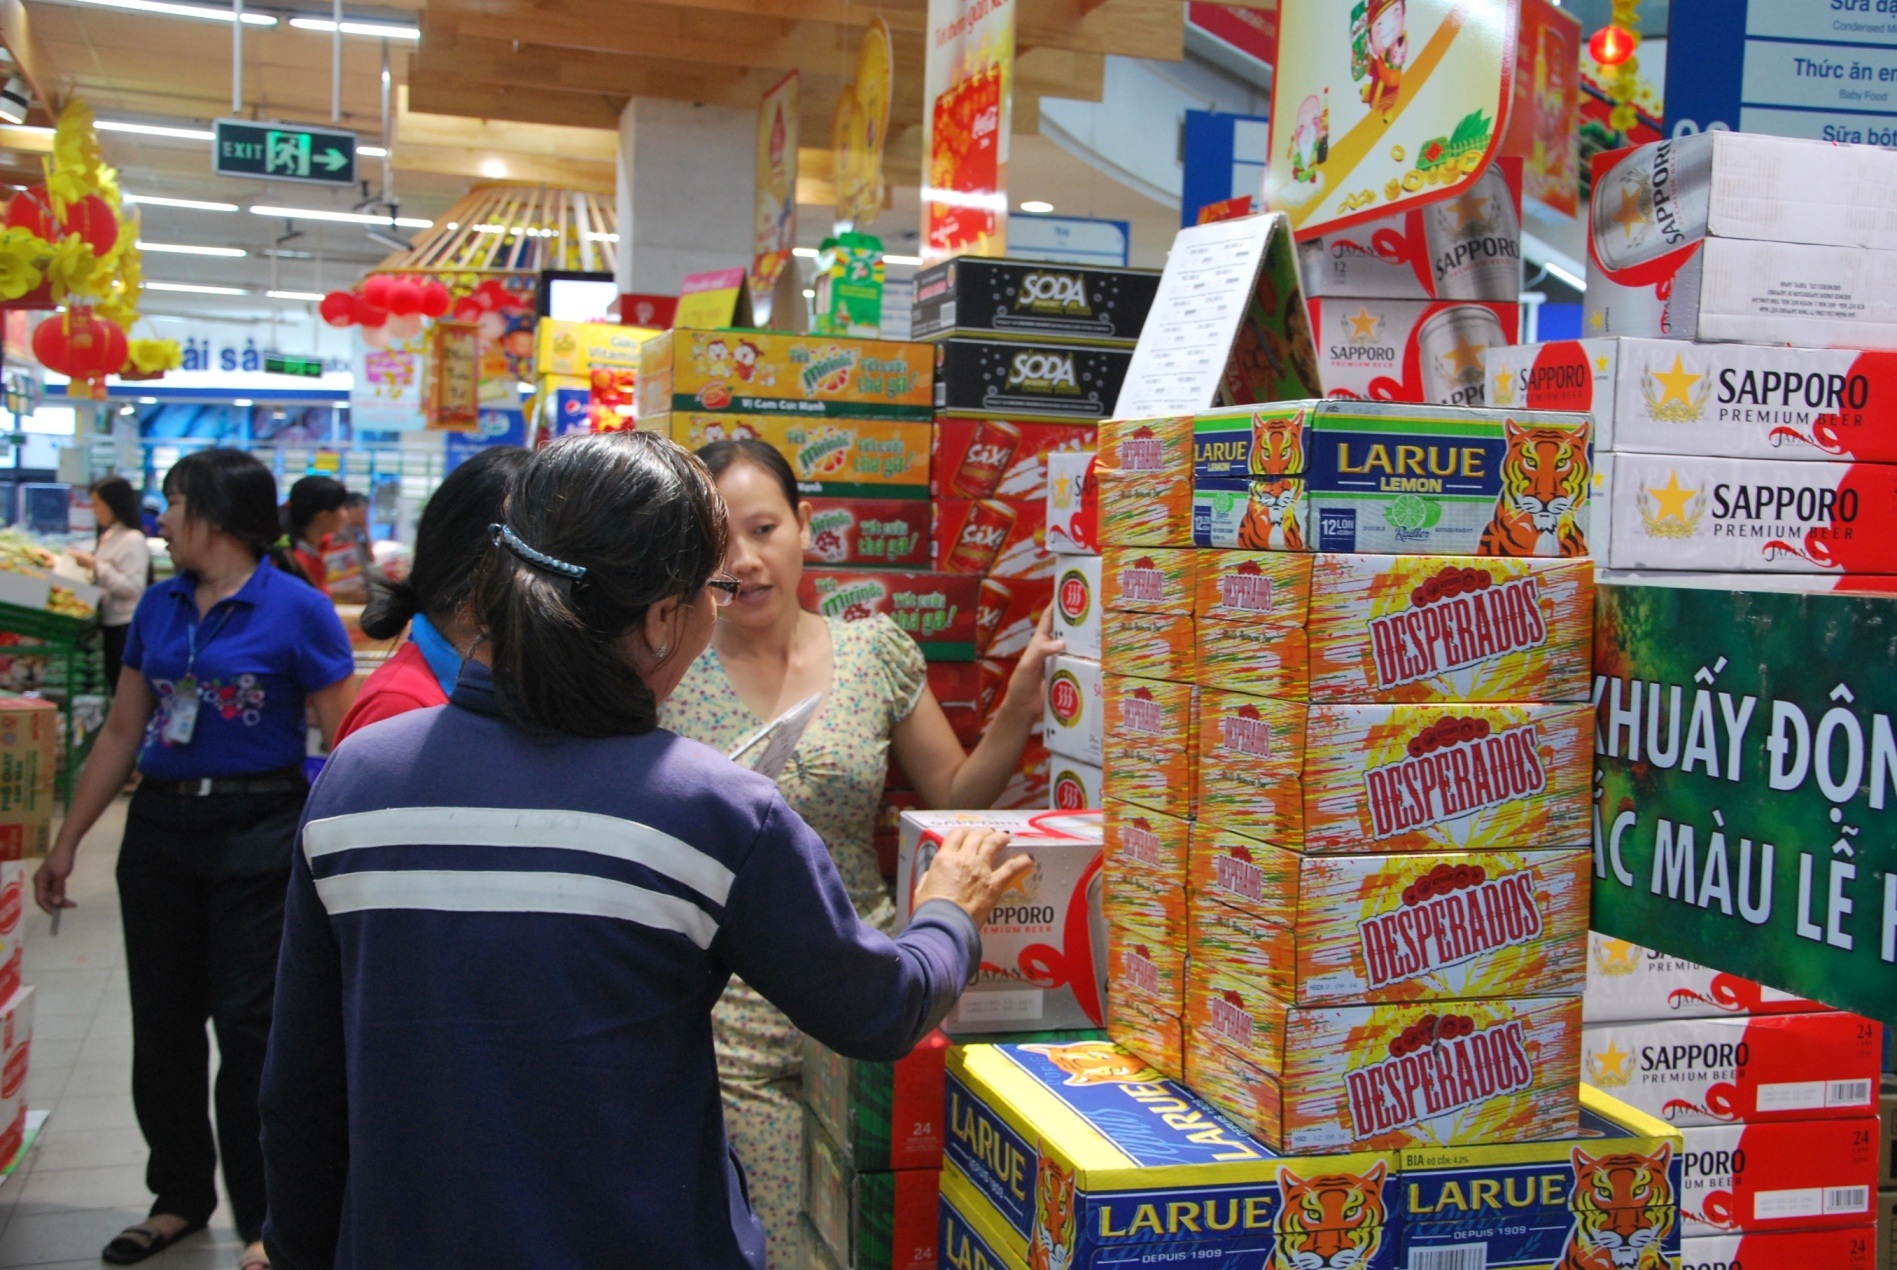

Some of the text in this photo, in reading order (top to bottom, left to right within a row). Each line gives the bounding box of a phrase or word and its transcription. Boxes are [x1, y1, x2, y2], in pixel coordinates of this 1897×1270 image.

[1794, 57, 1843, 79] Thức
[1850, 61, 1872, 80] ăn
[1839, 89, 1888, 102] Baby Food
[223, 141, 263, 160] EXIT
[1333, 261, 1346, 273] 12
[1435, 237, 1521, 281] SAPPORO
[1019, 274, 1087, 308] SODA
[1330, 345, 1395, 362] SAPPORO
[1009, 353, 1075, 387] SODA
[1519, 364, 1585, 392] SAPPORO
[1717, 368, 1869, 410] SAPPORO
[1719, 409, 1864, 427] PREMIUM BEER
[1195, 441, 1247, 462] LARUE
[1337, 443, 1487, 478] LARUE
[1380, 477, 1443, 493] LEMON
[1712, 484, 1859, 522] SAPPORO
[1321, 518, 1336, 536] 12
[1394, 525, 1430, 543] Radler
[1713, 523, 1854, 539] PREMIUM BEER
[1373, 580, 1543, 685] DESPERADOS
[1368, 728, 1542, 836] DESPERADOS
[1650, 809, 1775, 925] MÀU
[1796, 824, 1860, 951] LỄ
[985, 906, 1054, 925] APPORO
[980, 925, 1022, 934] EMIUM
[1362, 873, 1540, 985] DESPERADOS
[1648, 962, 1708, 972] PREMIU
[1856, 1024, 1873, 1040] 24
[1640, 1042, 1749, 1073] SAPPORO
[1348, 1023, 1530, 1137] DESPERADOS
[1642, 1069, 1746, 1083] PREMIUM BEER
[914, 1122, 932, 1136] 24
[1118, 1083, 1263, 1162] LARUE
[951, 1092, 1026, 1201] LARUE
[1853, 1130, 1869, 1146] 24
[1406, 1154, 1424, 1166] BIA
[1684, 1150, 1746, 1177] PORO
[1710, 1177, 1743, 1188] BEER
[1407, 1174, 1567, 1214] LARUE
[1099, 1196, 1274, 1239] LARUE
[1453, 1225, 1527, 1240] DEPUIS 1909
[914, 1247, 932, 1261] 24
[1141, 1248, 1222, 1264] DEPUIS 1909
[1850, 1239, 1866, 1255] 24
